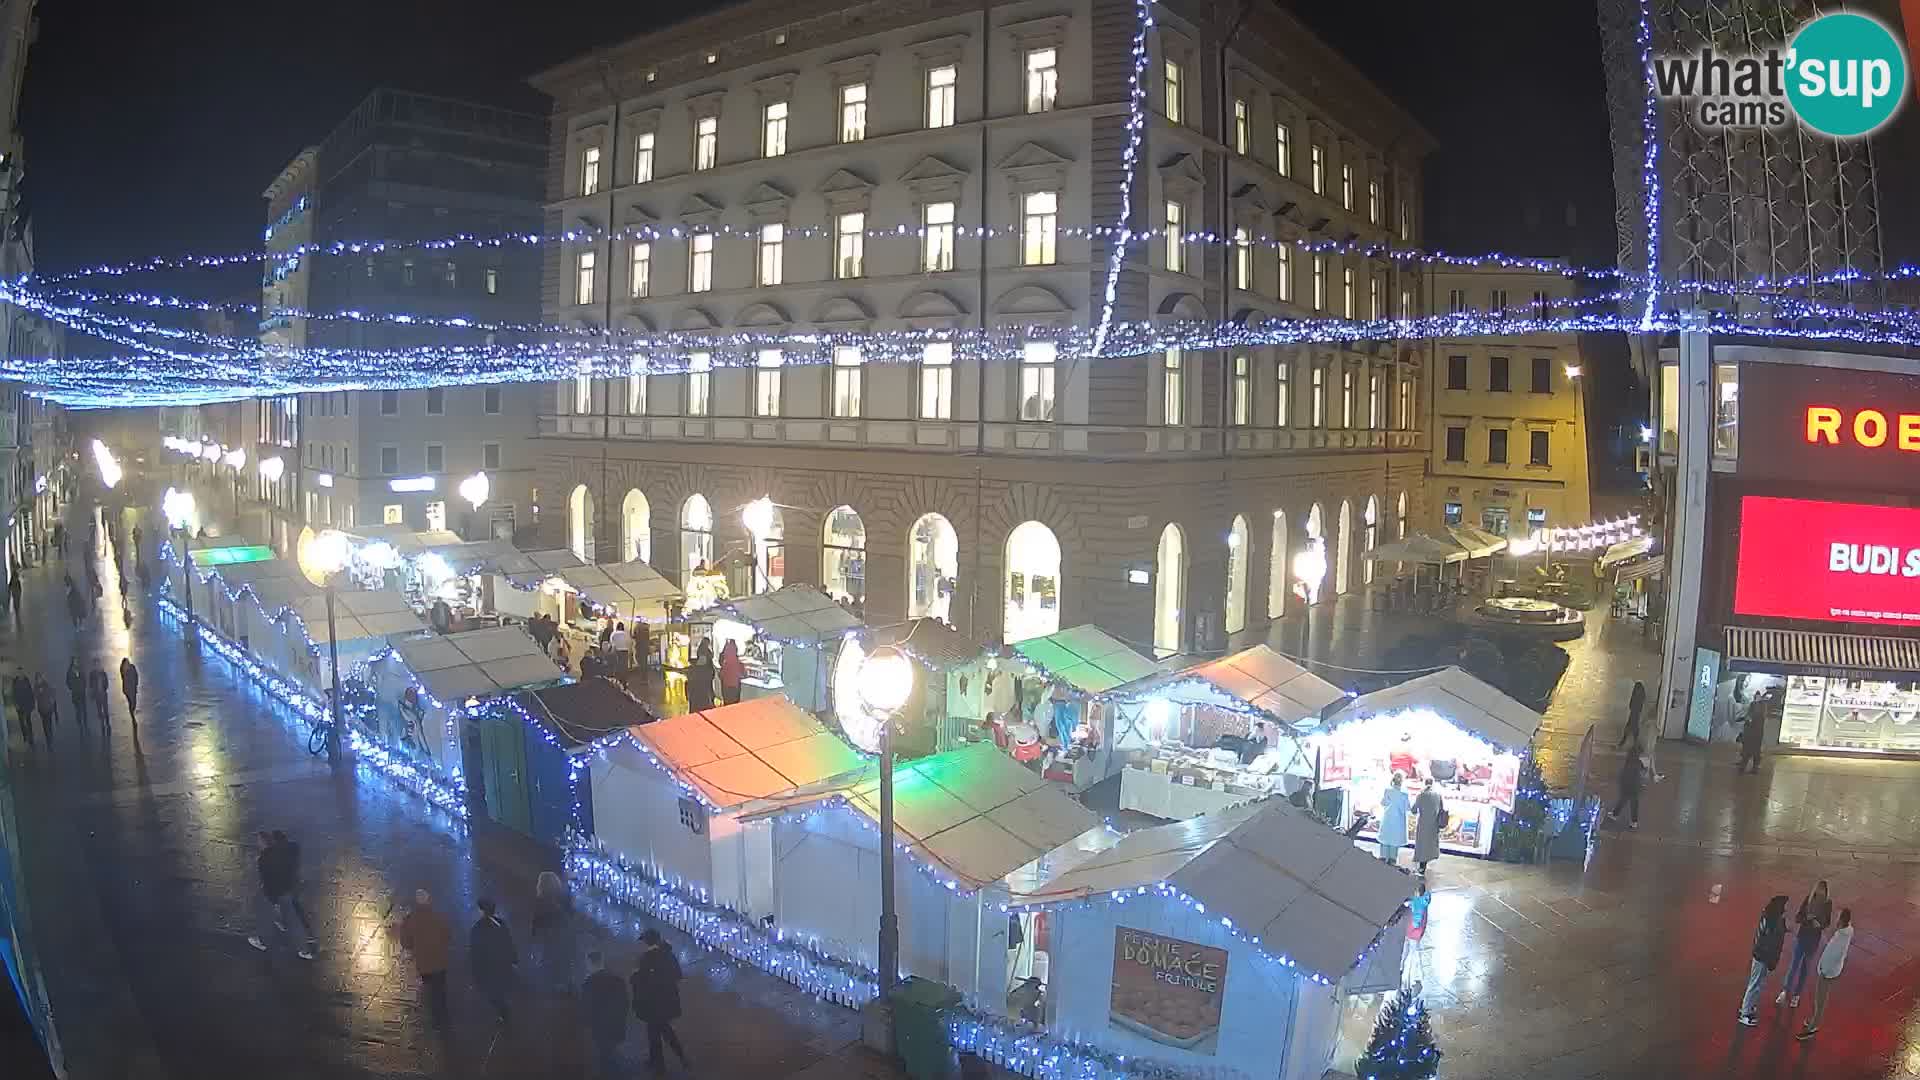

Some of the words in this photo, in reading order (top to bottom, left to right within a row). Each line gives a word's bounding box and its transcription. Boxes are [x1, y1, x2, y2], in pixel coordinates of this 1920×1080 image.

[1829, 542, 1899, 576] BUDI
[1123, 944, 1220, 980] DOMAĆE
[1155, 971, 1217, 993] FRITULE
